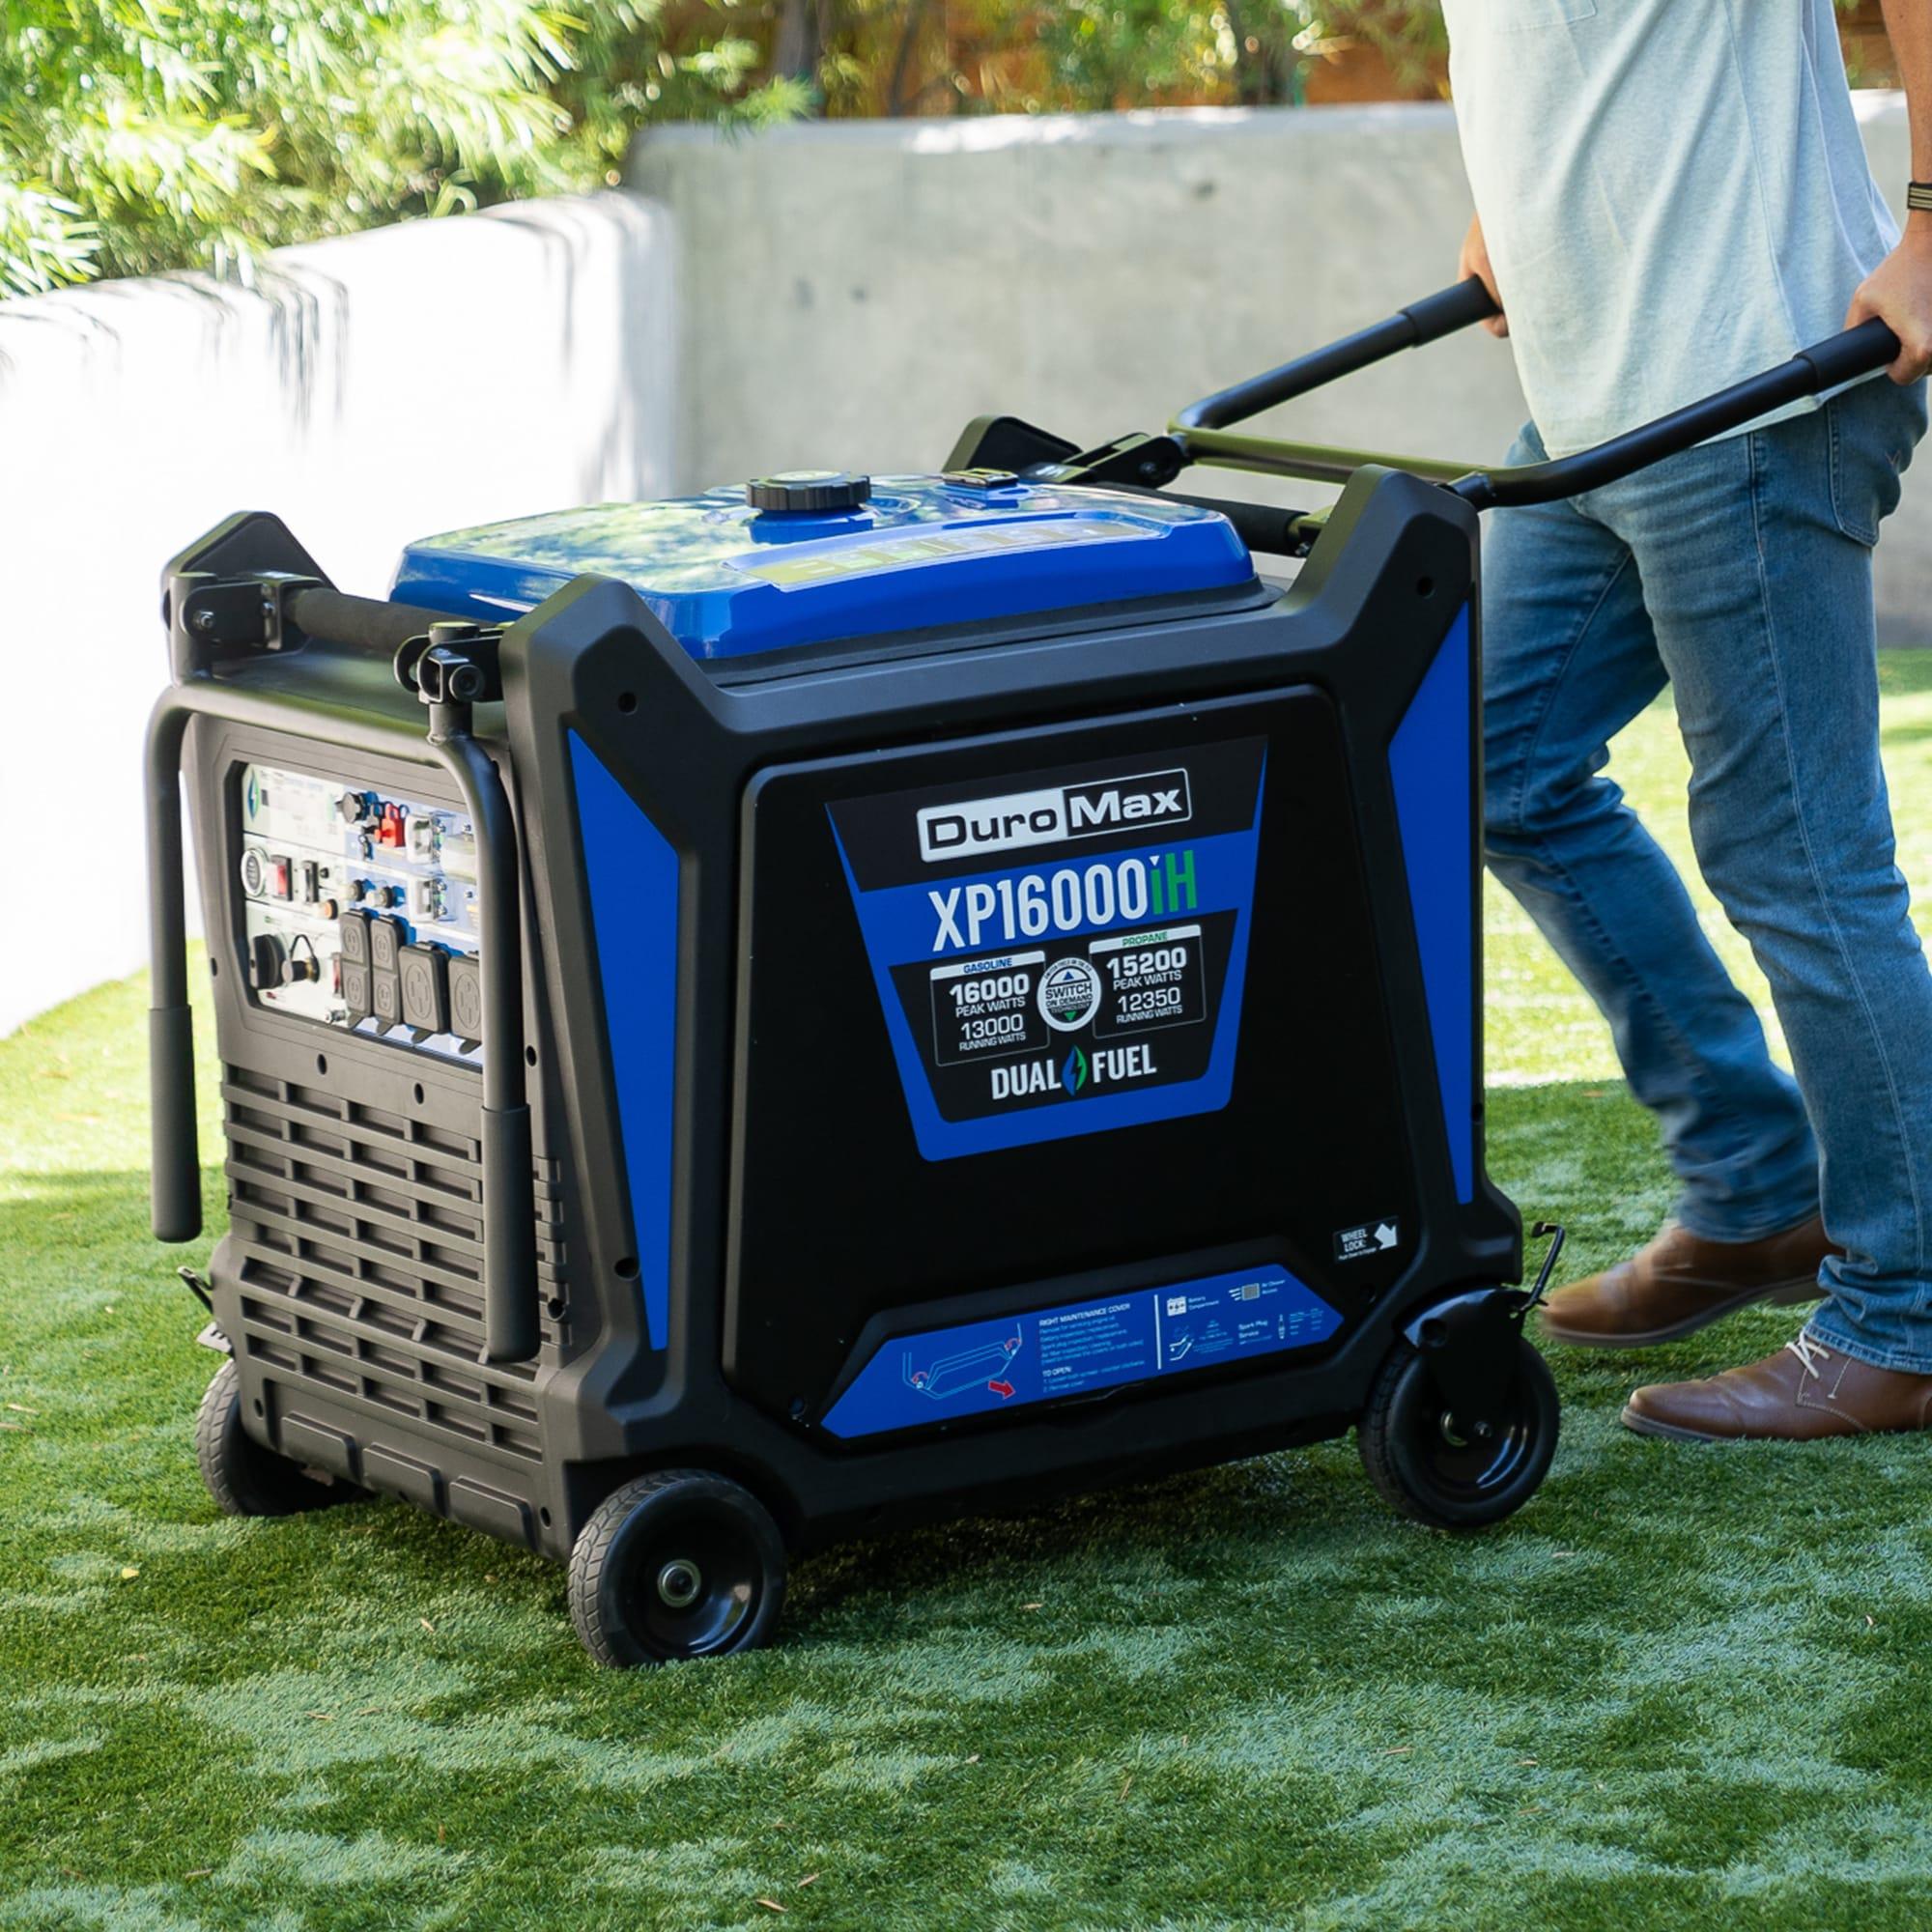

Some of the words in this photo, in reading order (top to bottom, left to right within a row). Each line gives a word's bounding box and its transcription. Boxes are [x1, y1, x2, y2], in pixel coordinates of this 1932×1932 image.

[926, 788, 1182, 851] DuroMax
[928, 849, 1198, 952] XP16000iH
[1122, 931, 1168, 947] PROPANE
[963, 957, 1012, 974] GASOLINE
[1106, 947, 1188, 980] 15200
[950, 973, 1031, 1006] 16000
[1045, 981, 1093, 1000] SWITCH
[1113, 976, 1143, 991] PEAK
[1144, 969, 1182, 985] WATTS
[955, 1003, 985, 1018] PEAK
[986, 996, 1026, 1012] WATTS
[1059, 993, 1094, 1005] DEMAND
[1117, 987, 1181, 1013] 12350
[1116, 1010, 1154, 1024] RUNNING
[1154, 1005, 1183, 1018] WATTS
[960, 1013, 1024, 1040] 13000
[959, 1037, 998, 1051] RUNNING
[998, 1031, 1027, 1044] WATTS
[990, 1059, 1062, 1100] DUAL
[1092, 1043, 1157, 1084] FUEL
[1341, 1228, 1368, 1243] WHEEL
[1038, 1317, 1059, 1326] RIGHT
[1108, 1303, 1130, 1314] COVER
